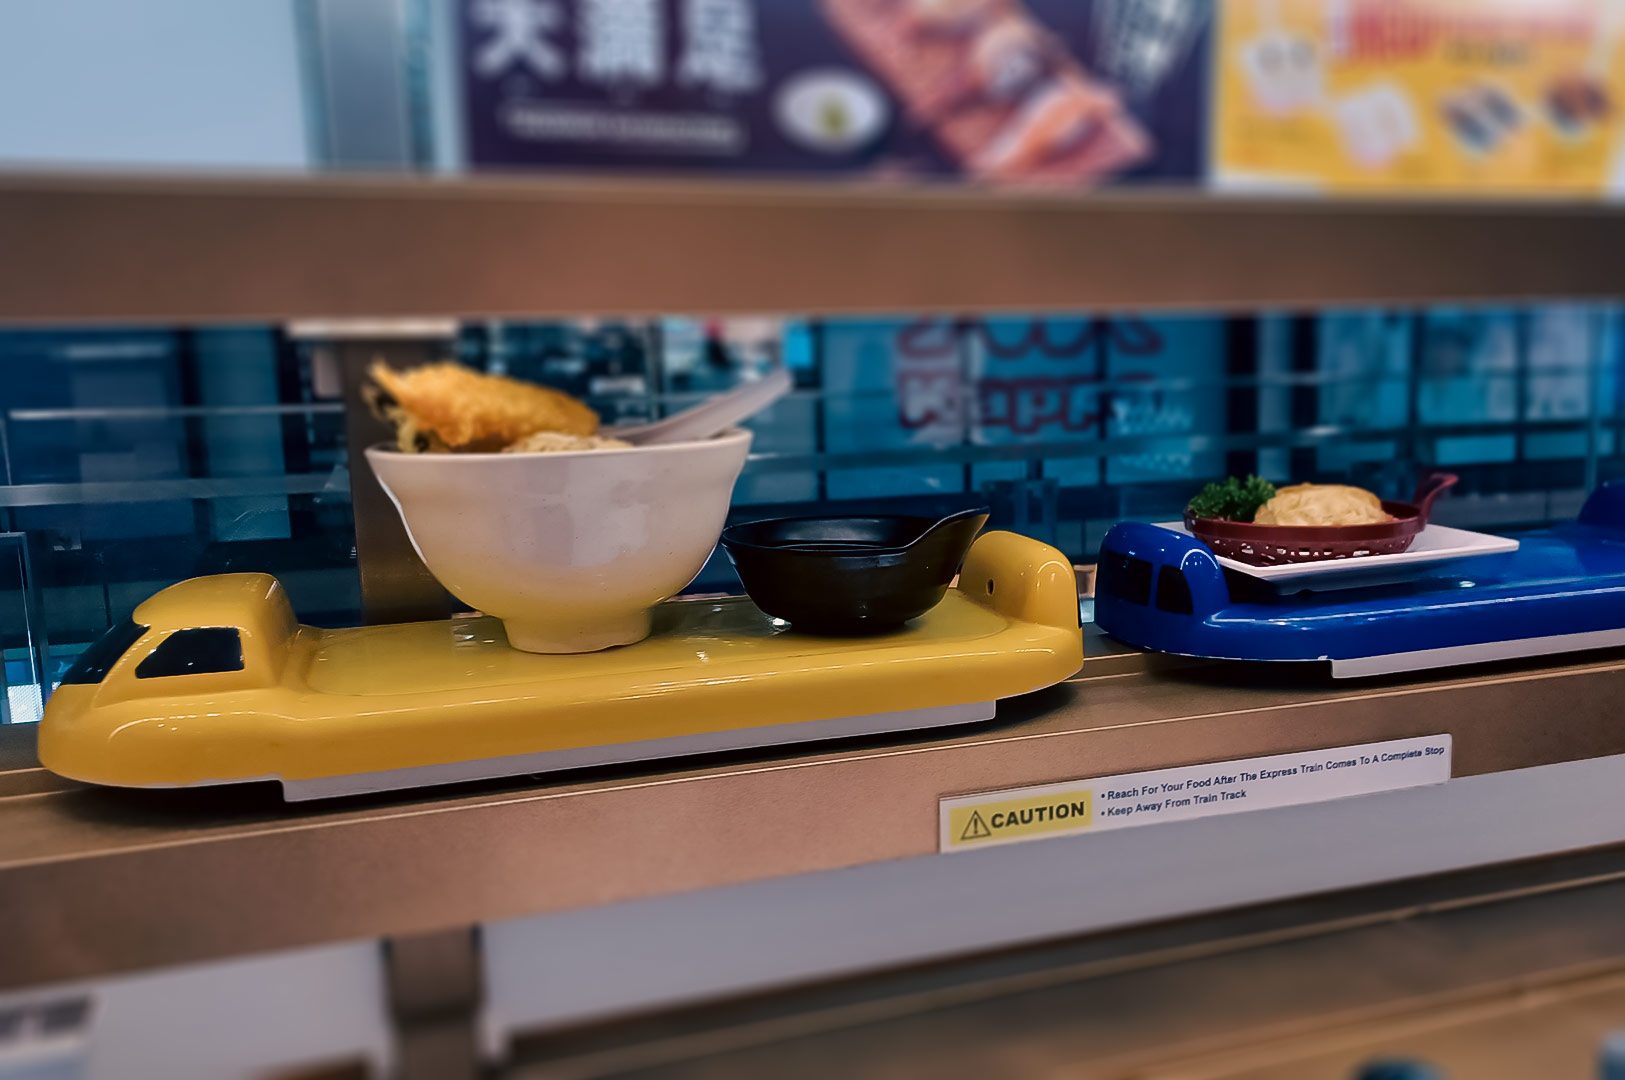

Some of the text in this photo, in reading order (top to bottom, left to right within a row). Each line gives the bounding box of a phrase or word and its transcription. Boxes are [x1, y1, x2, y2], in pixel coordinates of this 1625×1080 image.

[1107, 745, 1445, 800] Reach For Your Food After The Express Train Comes To A Complete Stop
[990, 801, 1085, 829] CAUTION
[1107, 788, 1247, 818] Keep Away From Train Track
